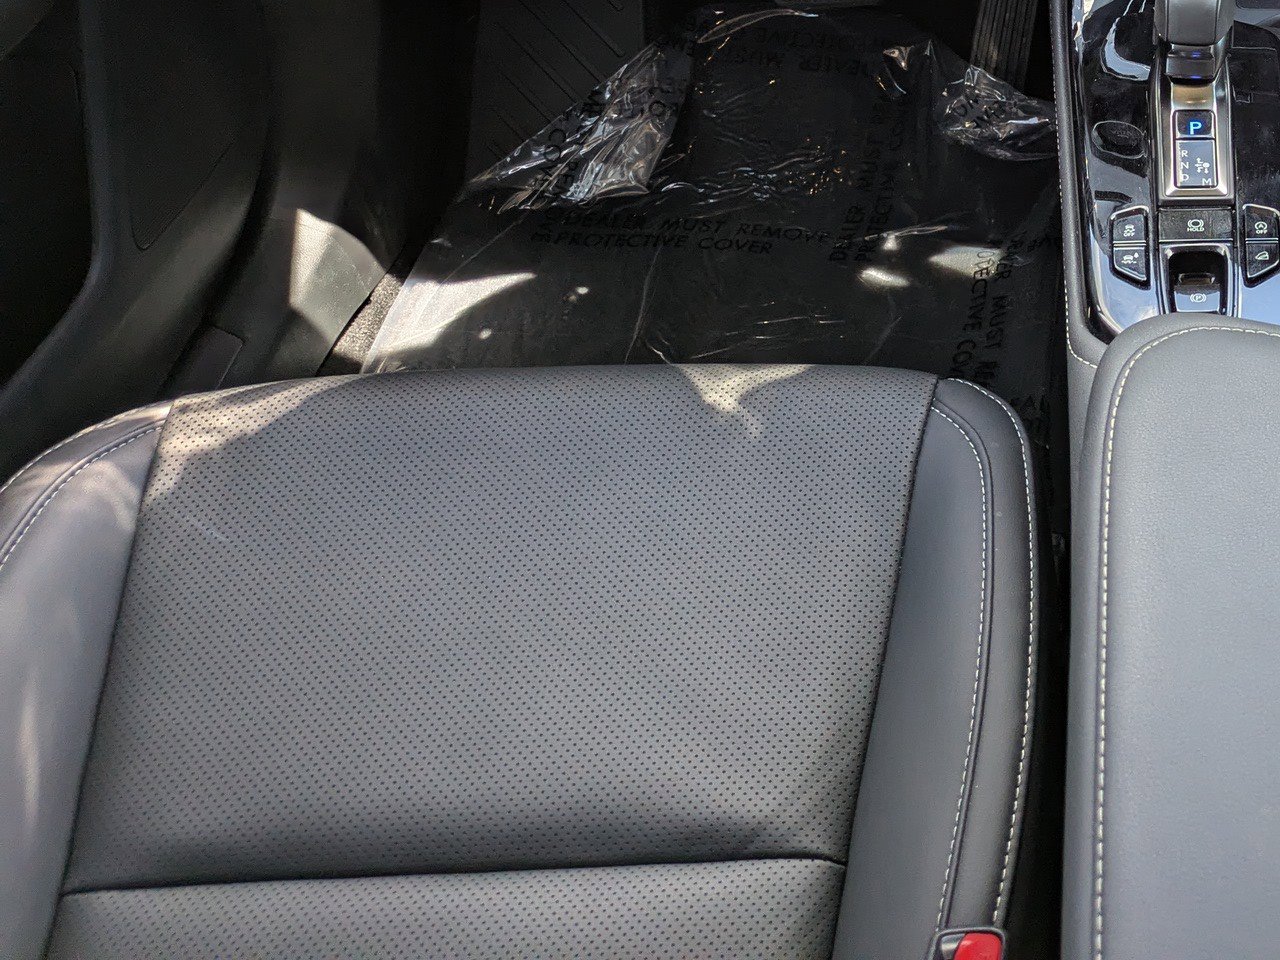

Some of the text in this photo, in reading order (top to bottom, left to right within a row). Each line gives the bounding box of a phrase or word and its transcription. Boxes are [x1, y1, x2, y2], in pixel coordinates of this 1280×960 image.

[1190, 121, 1202, 135] P
[1180, 161, 1189, 169] N
[1180, 173, 1189, 181] D
[1202, 177, 1212, 186] M
[660, 217, 726, 235] MUST
[736, 223, 831, 243] REMOVE
[553, 231, 773, 255] PROTECTIVE COVER
[984, 294, 1009, 350] MUST
